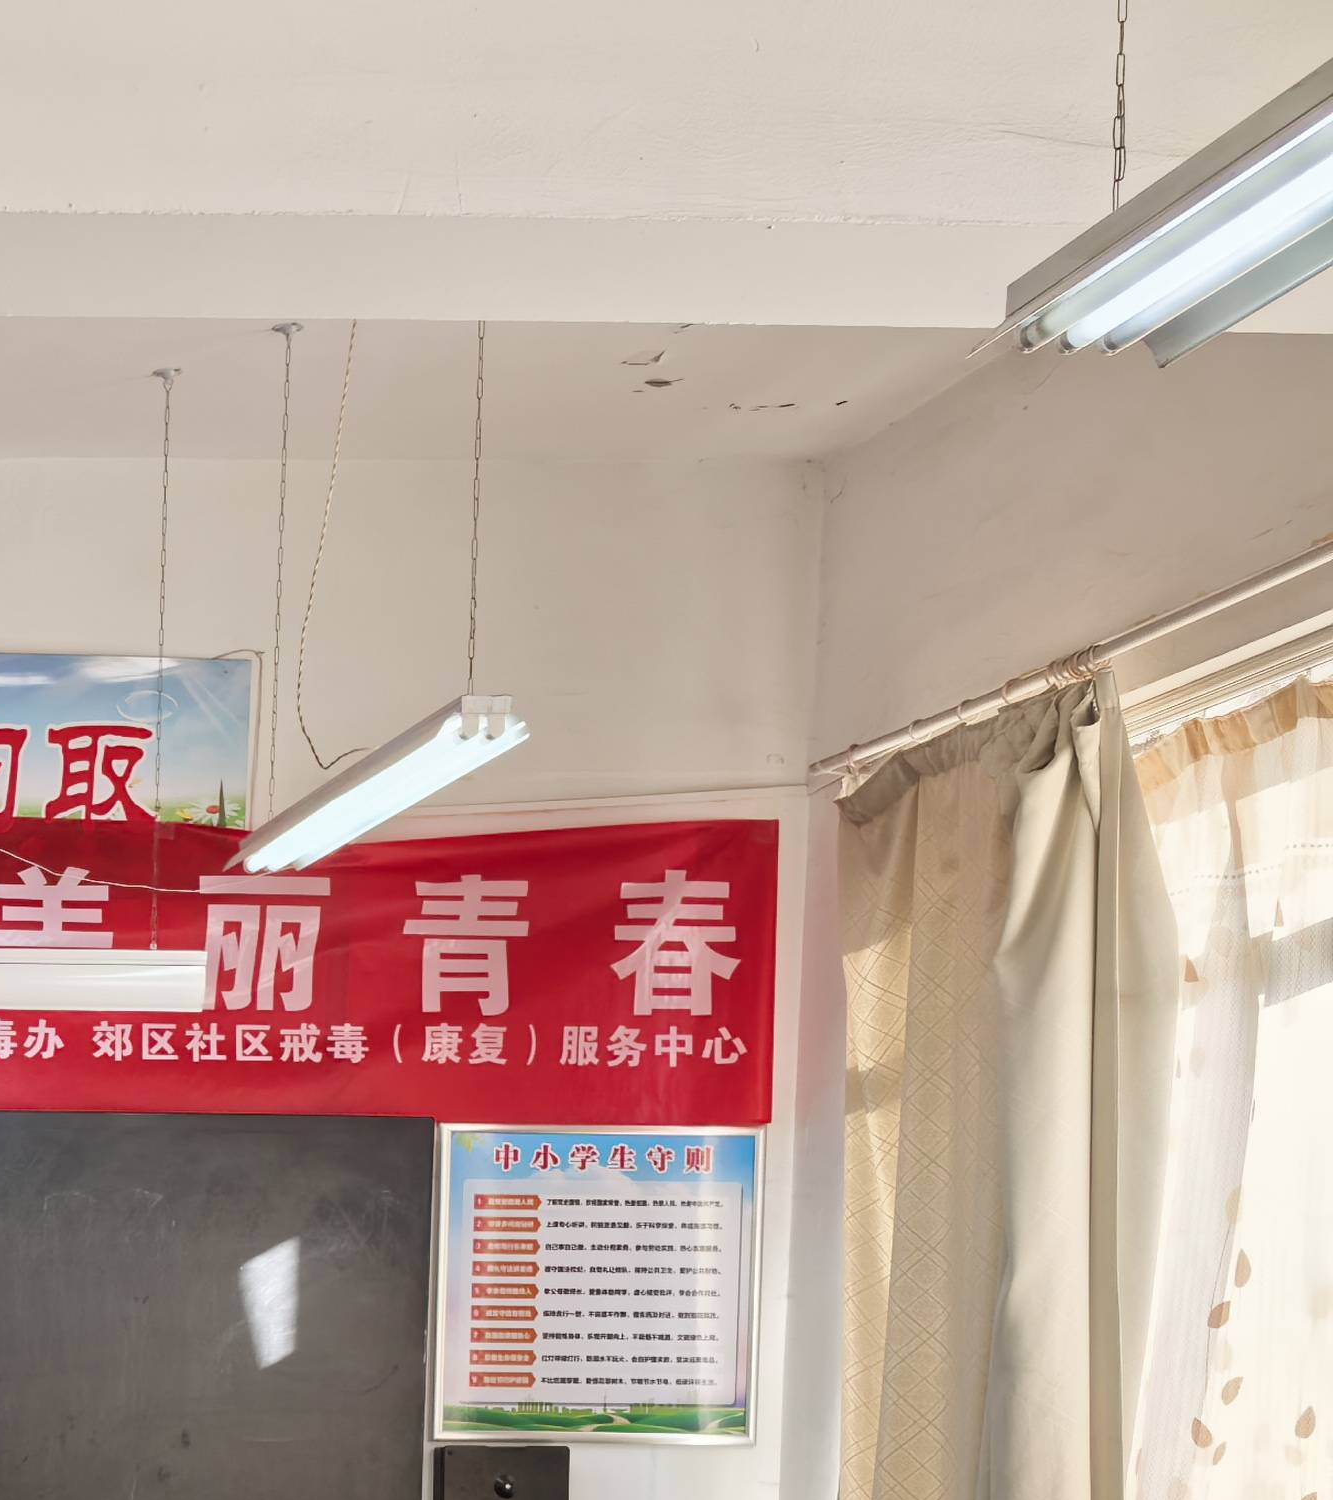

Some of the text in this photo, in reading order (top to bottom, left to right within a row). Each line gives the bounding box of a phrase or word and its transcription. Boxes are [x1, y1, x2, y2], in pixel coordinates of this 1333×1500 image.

[92, 1020, 747, 1068] 郊区社区戒毒（康复）服务中心
[494, 1143, 714, 1174] 中小学生守则
